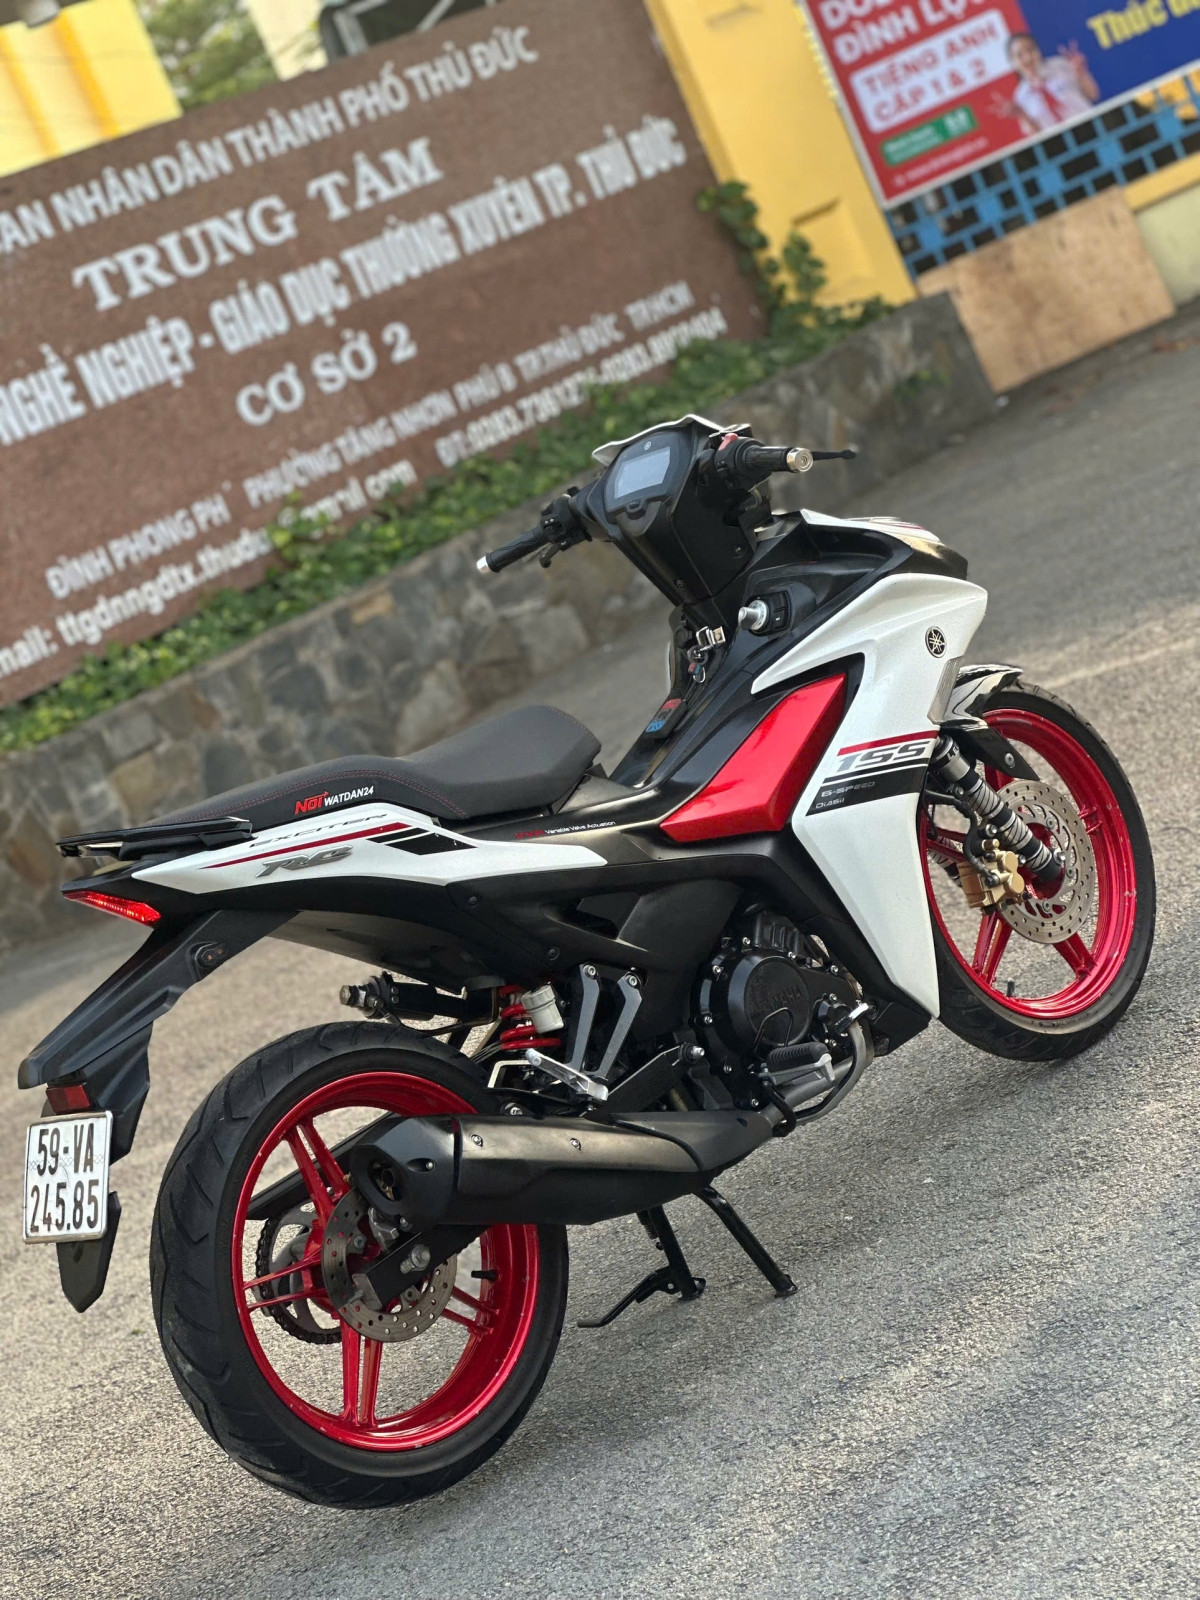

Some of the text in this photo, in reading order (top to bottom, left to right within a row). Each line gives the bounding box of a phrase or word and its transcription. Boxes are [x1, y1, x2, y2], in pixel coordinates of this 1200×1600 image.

[944, 22, 999, 61] ANH
[969, 57, 988, 79] 2
[50, 165, 158, 232] NHÂN
[151, 139, 234, 197] DÂN
[225, 107, 346, 168] THÀNH
[339, 60, 410, 127] PHỐ
[403, 41, 473, 103] THỦ
[468, 26, 540, 81] ĐỨC
[72, 135, 444, 312] TRUNG TÂM
[75, 315, 196, 408] NGHIỆP
[209, 278, 291, 356] GIÁO
[279, 257, 351, 326] DỤC
[340, 213, 461, 299] THƯỜNG
[448, 175, 546, 255] XUYÊN
[576, 123, 637, 200] THỦ
[627, 113, 688, 180] ĐỨC
[236, 321, 418, 426] CƠ SỞ 2
[835, 740, 933, 773] 155
[324, 785, 375, 807] WATDAN24
[821, 781, 876, 798] 6-SPEED
[36, 1122, 96, 1177] 59-VA
[30, 1178, 100, 1233] 245.85
